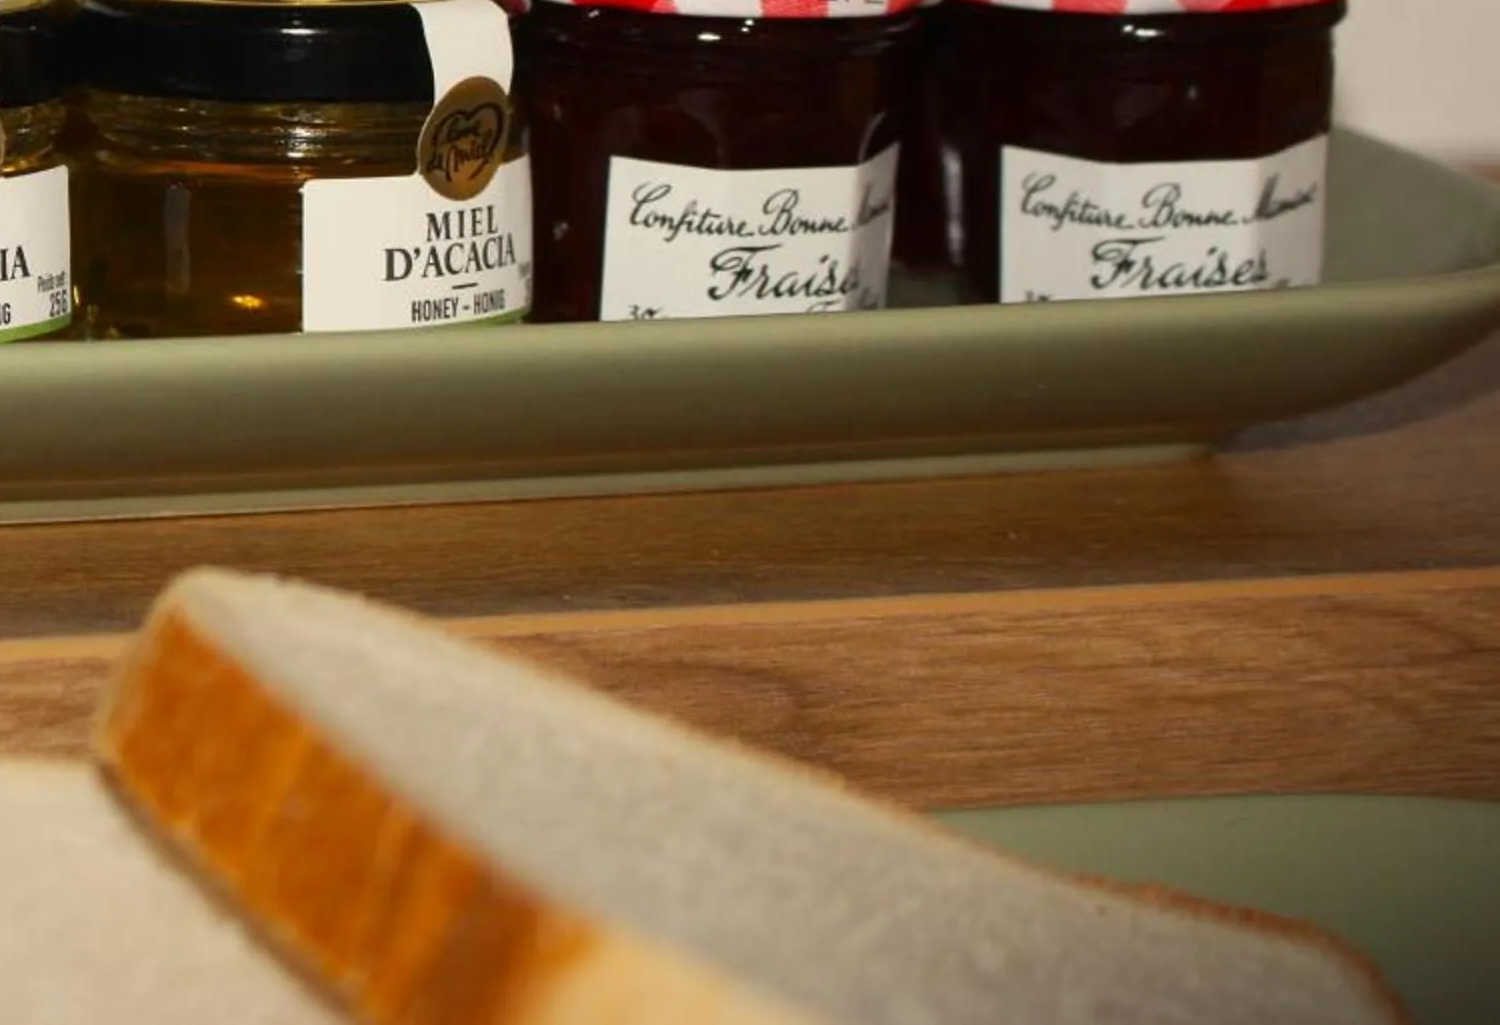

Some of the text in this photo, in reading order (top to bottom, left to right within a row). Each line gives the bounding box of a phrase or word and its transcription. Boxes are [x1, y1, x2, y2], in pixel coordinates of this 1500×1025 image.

[425, 204, 499, 243] MIEL
[630, 181, 755, 243] Confiture
[758, 188, 849, 236] Bonne
[1019, 171, 1134, 232] Confiture
[1139, 181, 1237, 229] Bonne
[383, 232, 517, 282] D'ACACIA
[1089, 235, 1271, 291] Fraises
[410, 296, 460, 322] HONEY
